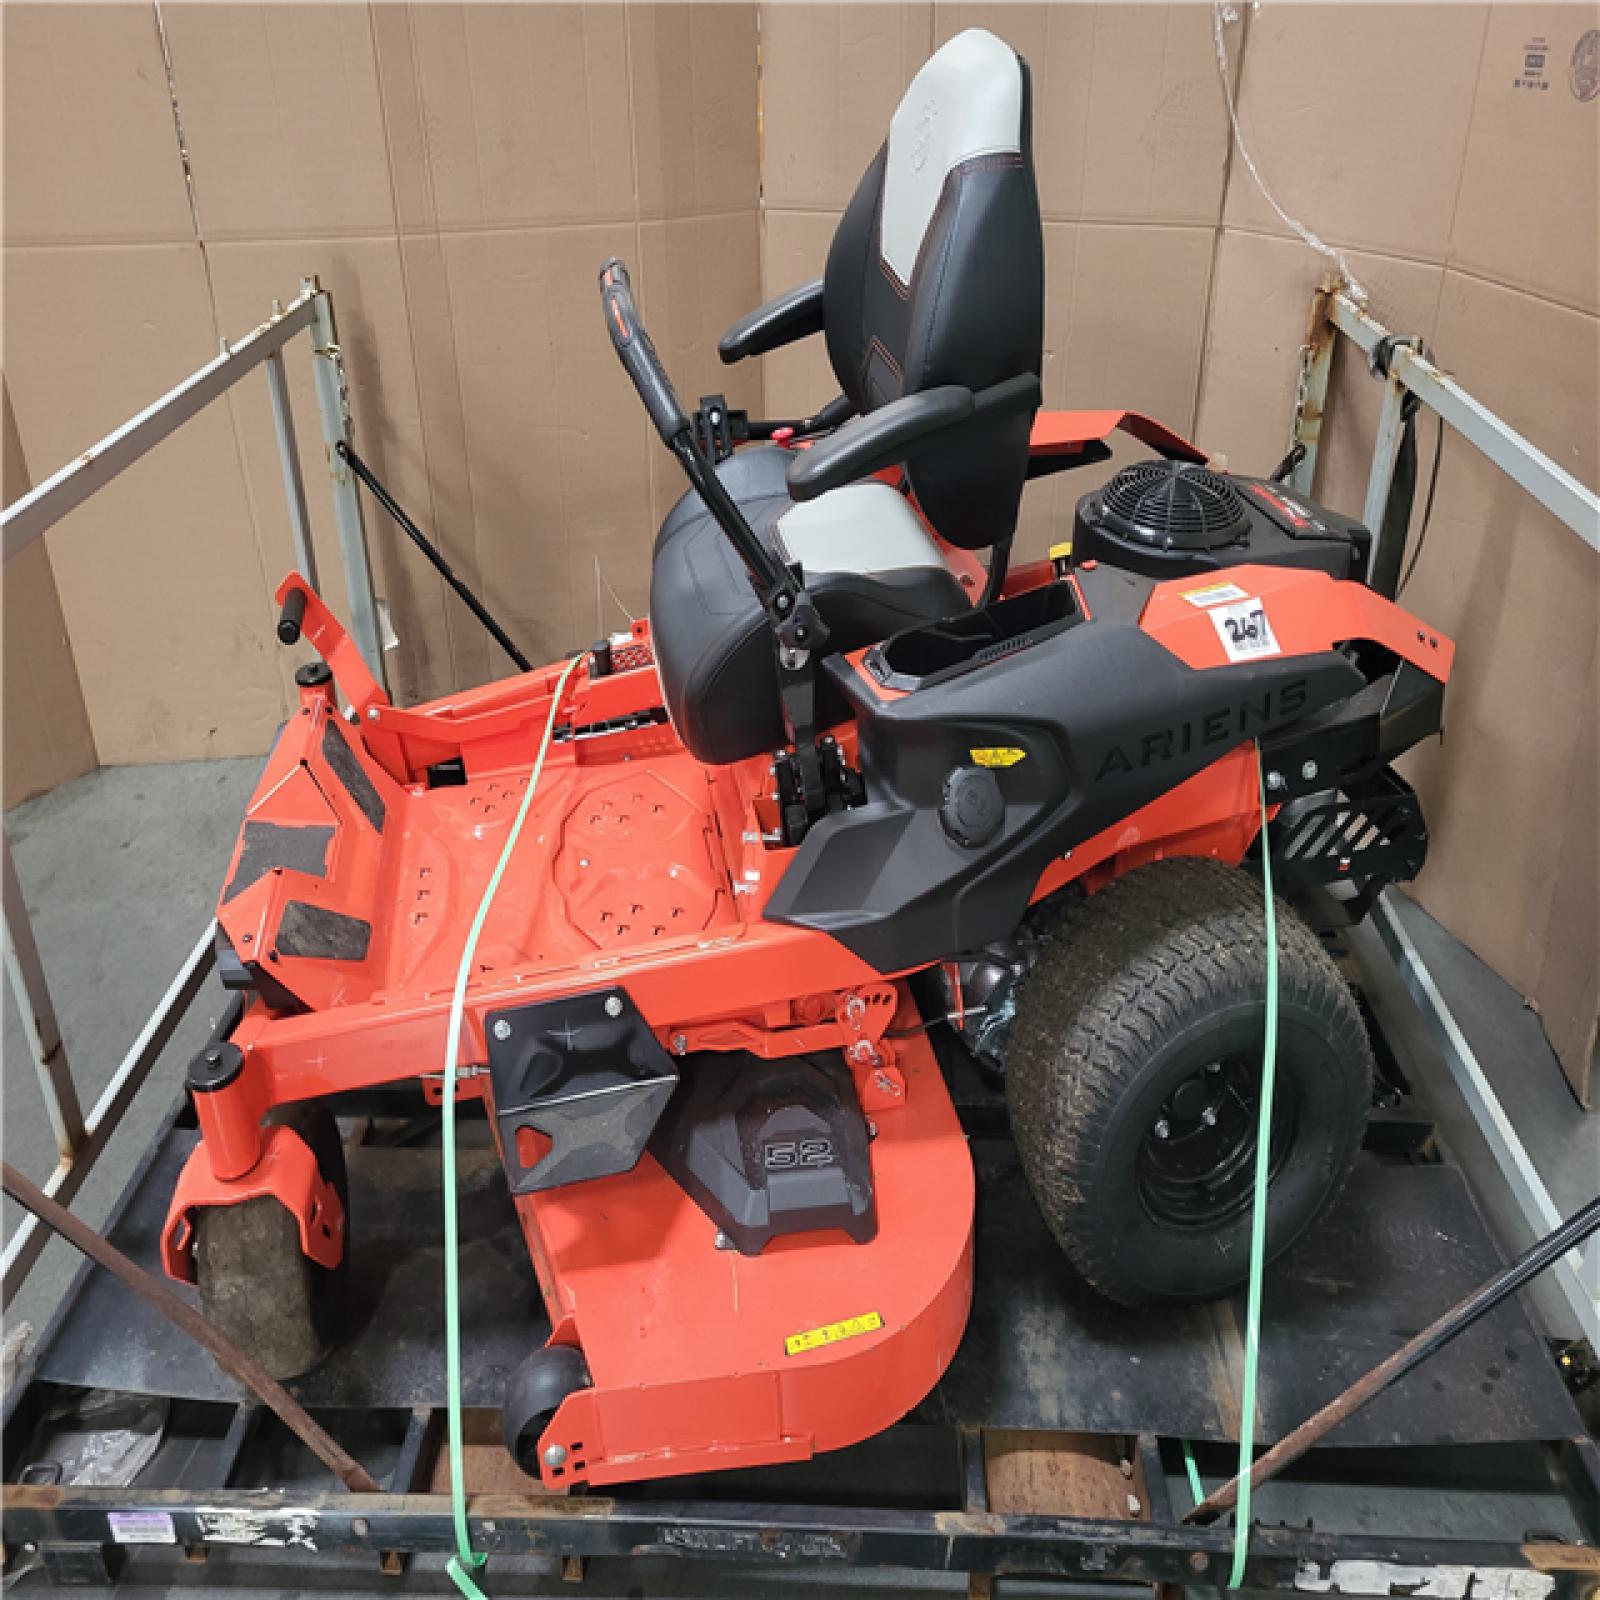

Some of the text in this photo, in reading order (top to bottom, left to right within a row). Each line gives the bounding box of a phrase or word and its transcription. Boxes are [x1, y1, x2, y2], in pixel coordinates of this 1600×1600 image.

[1225, 609, 1266, 643] 267
[1096, 682, 1306, 779] ARIENS
[764, 1139, 833, 1168] 52
